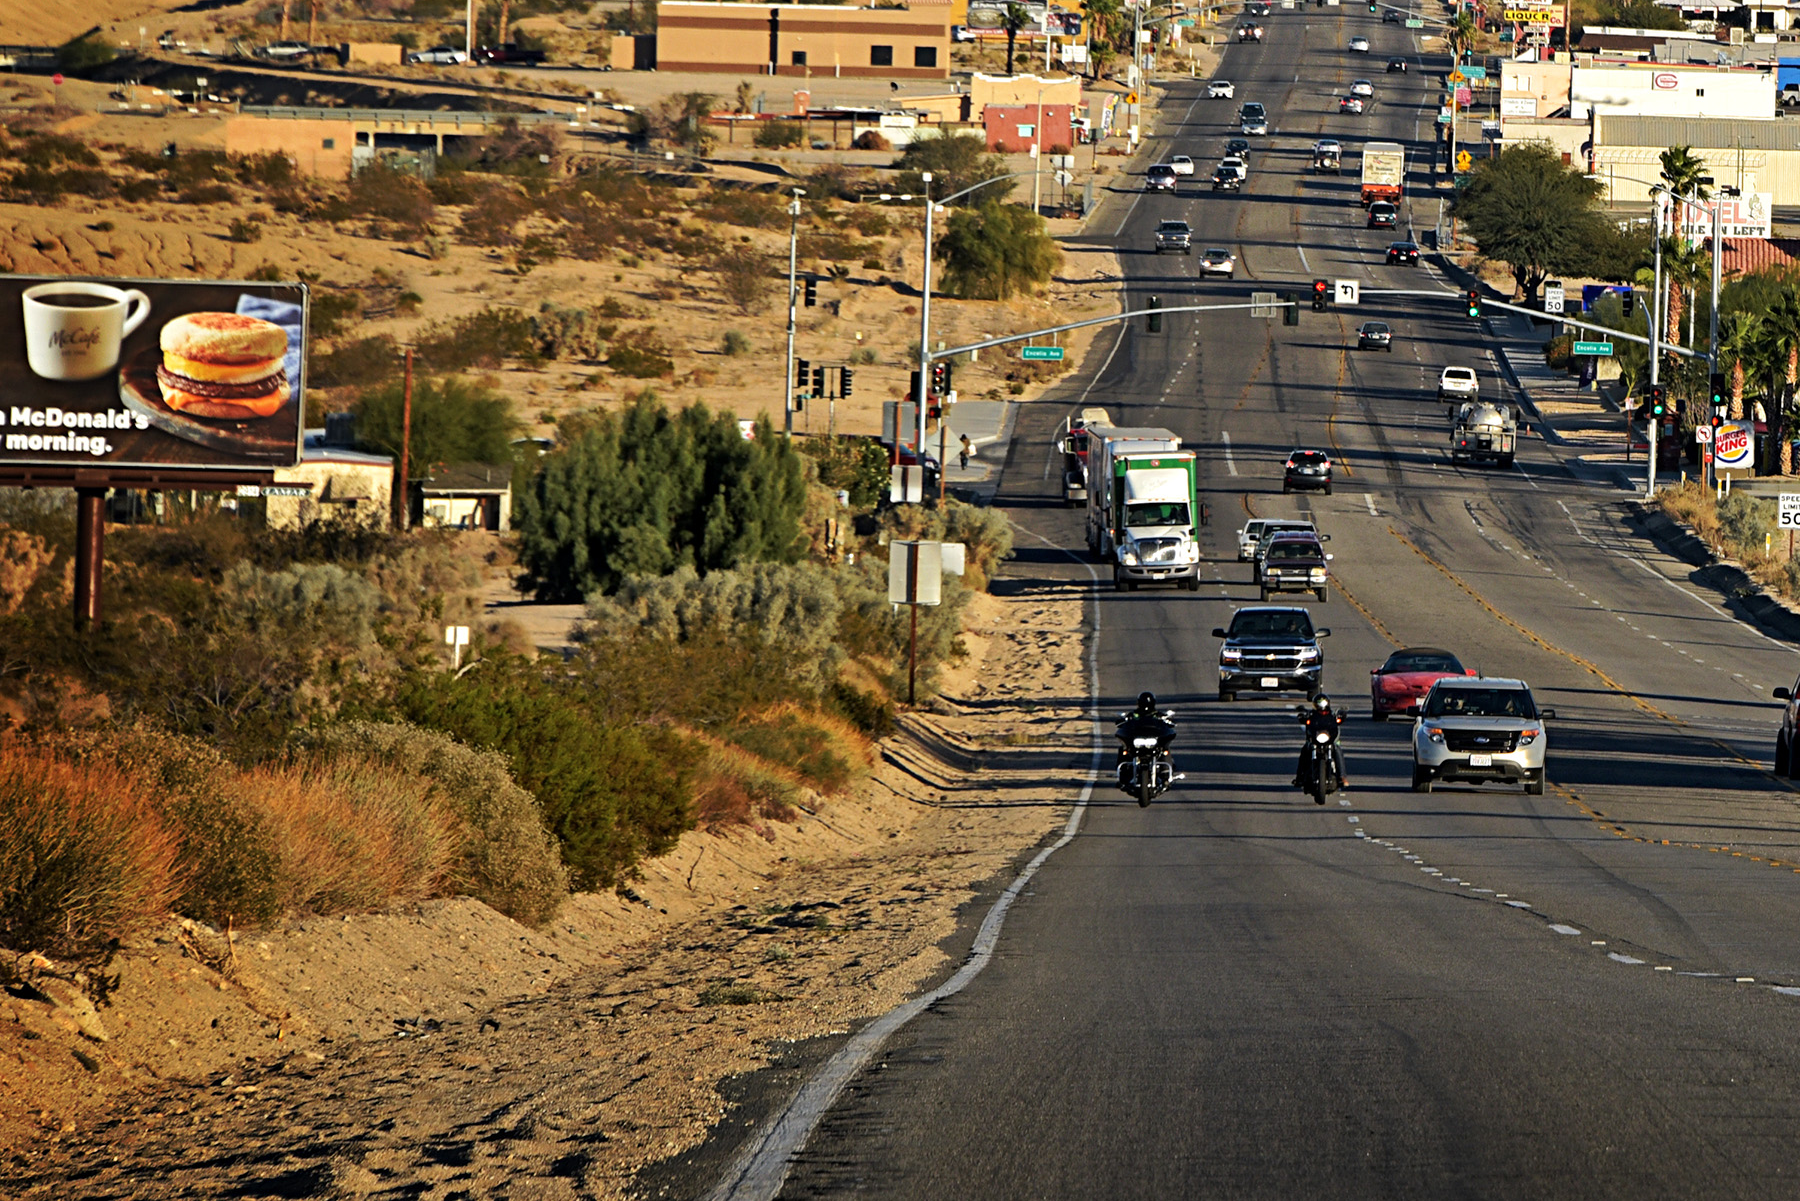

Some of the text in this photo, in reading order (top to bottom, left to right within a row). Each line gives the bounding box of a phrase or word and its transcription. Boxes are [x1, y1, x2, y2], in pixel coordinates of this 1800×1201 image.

[1664, 201, 1747, 224] OTEL
[1733, 226, 1766, 236] LEFT
[1547, 301, 1562, 311] 50
[10, 406, 149, 430] McDonald's
[5, 430, 114, 456] morning.
[1716, 436, 1747, 455] KING
